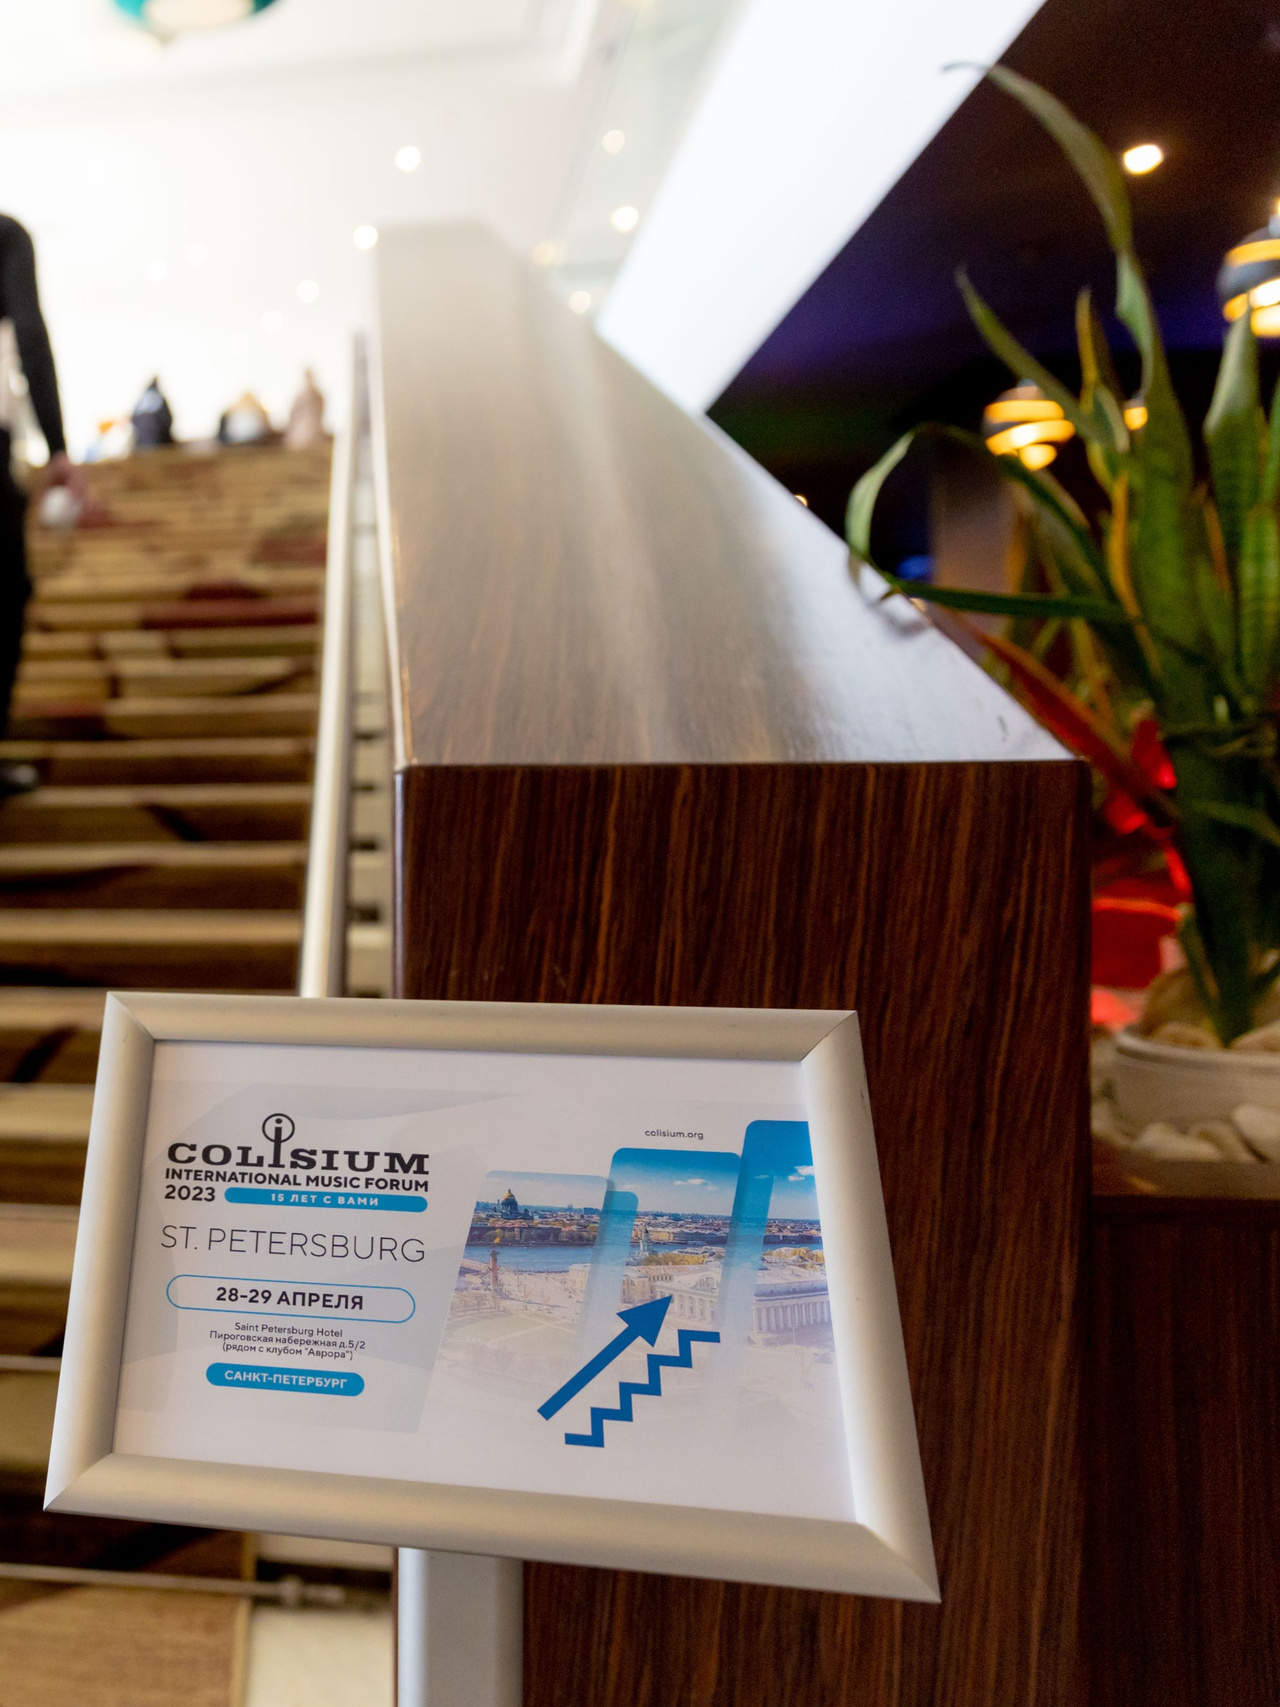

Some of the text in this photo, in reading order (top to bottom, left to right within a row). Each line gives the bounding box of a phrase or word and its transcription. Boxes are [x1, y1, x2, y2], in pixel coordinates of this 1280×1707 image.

[644, 1129, 704, 1140] colisium.org
[165, 1168, 428, 1192] INTERNATIONAL MUSIC FORUM
[164, 1185, 216, 1202] 2023
[271, 1193, 379, 1206] 15 ЛЕТ С ВАМИ
[161, 1225, 425, 1262] ST. PETERSBURG
[216, 1287, 363, 1310] 28-29 АПРЕЛЯ
[235, 1323, 343, 1337] Saint Petersburg Hotel
[210, 1331, 366, 1350] Пироговская набережная д.5/2
[222, 1342, 257, 1354] (рядом
[266, 1346, 303, 1357] клубом
[304, 1348, 353, 1361] "Аврора")
[224, 1370, 348, 1389] САНКТ-ПЕТЕРБУРГ
